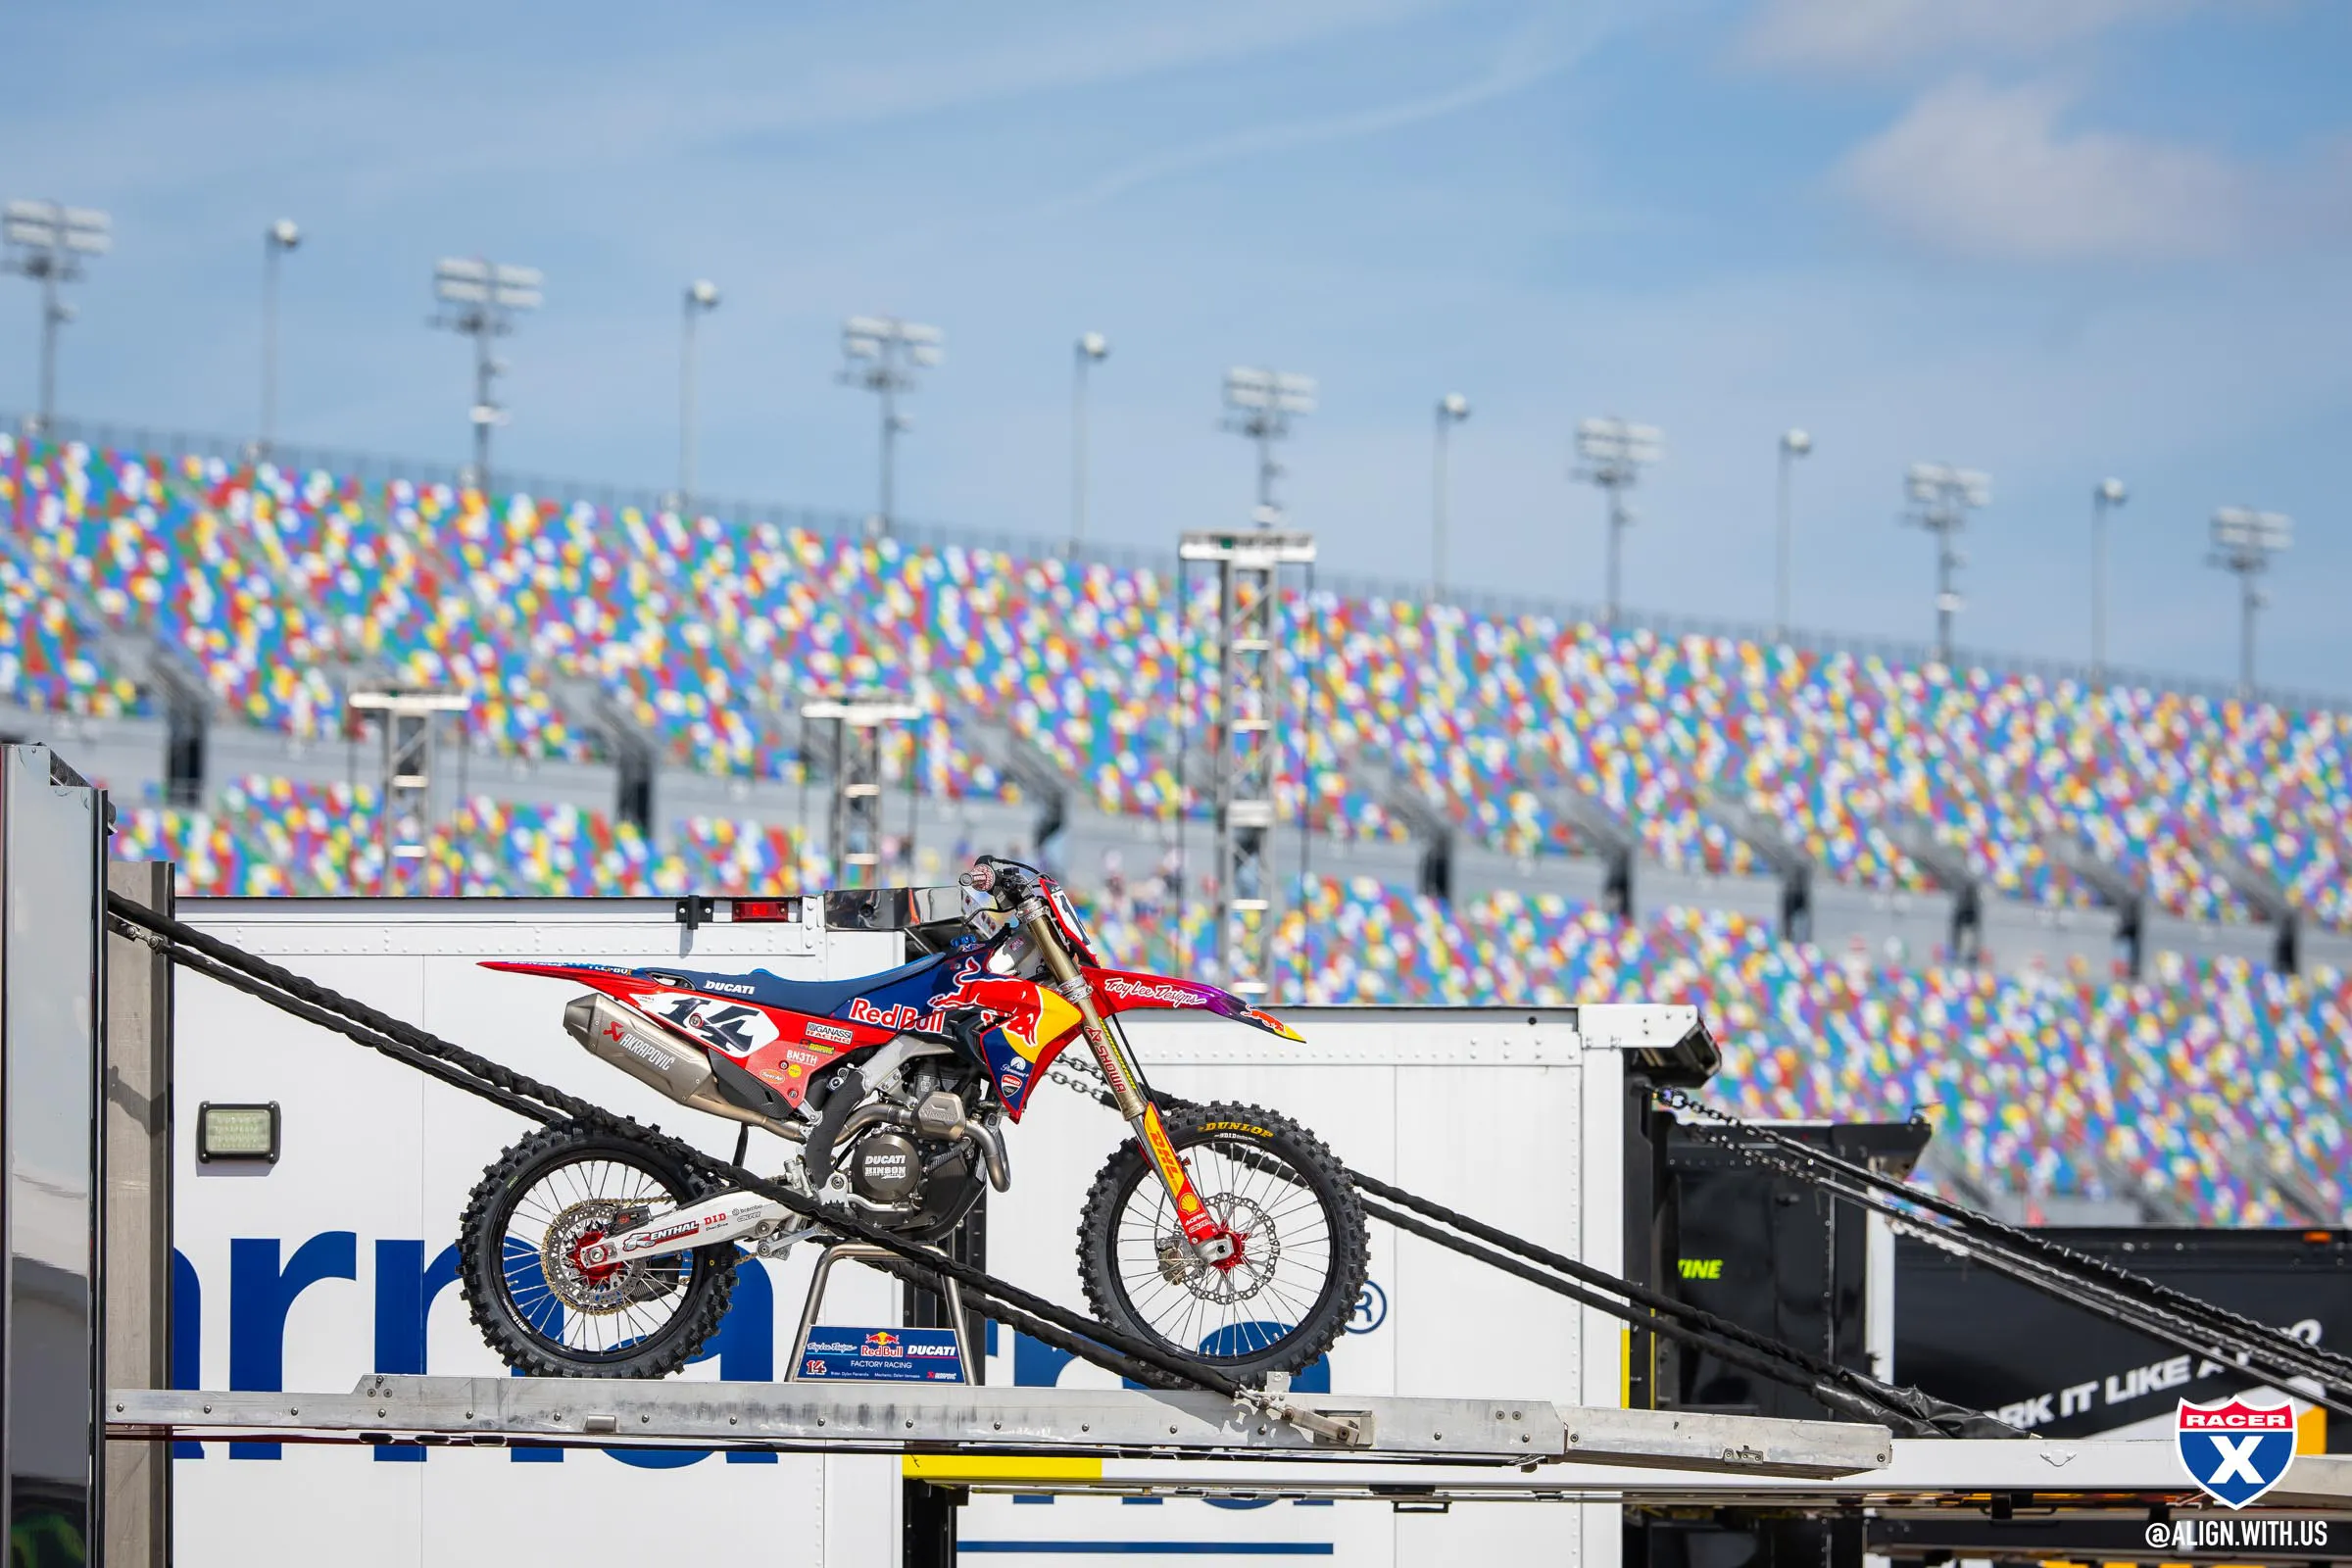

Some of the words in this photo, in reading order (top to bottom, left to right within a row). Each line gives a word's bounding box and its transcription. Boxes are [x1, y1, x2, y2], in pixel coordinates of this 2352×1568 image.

[703, 980, 756, 995] DUCATI
[1104, 978, 1132, 999] Troy
[1131, 981, 1153, 998] Lee
[1152, 985, 1206, 1007] Designs
[849, 998, 902, 1029] Red
[898, 1006, 946, 1034] Bull
[658, 997, 760, 1053] 14
[815, 1024, 853, 1038] GANASSI
[807, 1030, 851, 1044] RACING
[786, 1049, 818, 1065] BN3TH
[1095, 1045, 1127, 1094] SHOWA
[1205, 1121, 1275, 1137] DUNLOP
[864, 1155, 906, 1164] DUCATI
[1150, 1132, 1180, 1180] DHL
[861, 1345, 882, 1356] Red
[882, 1346, 904, 1357] Bull
[907, 1345, 956, 1356] DUCATI
[807, 1360, 827, 1376] 14
[2060, 1381, 2099, 1418] IT
[2105, 1354, 2192, 1404] LIKE
